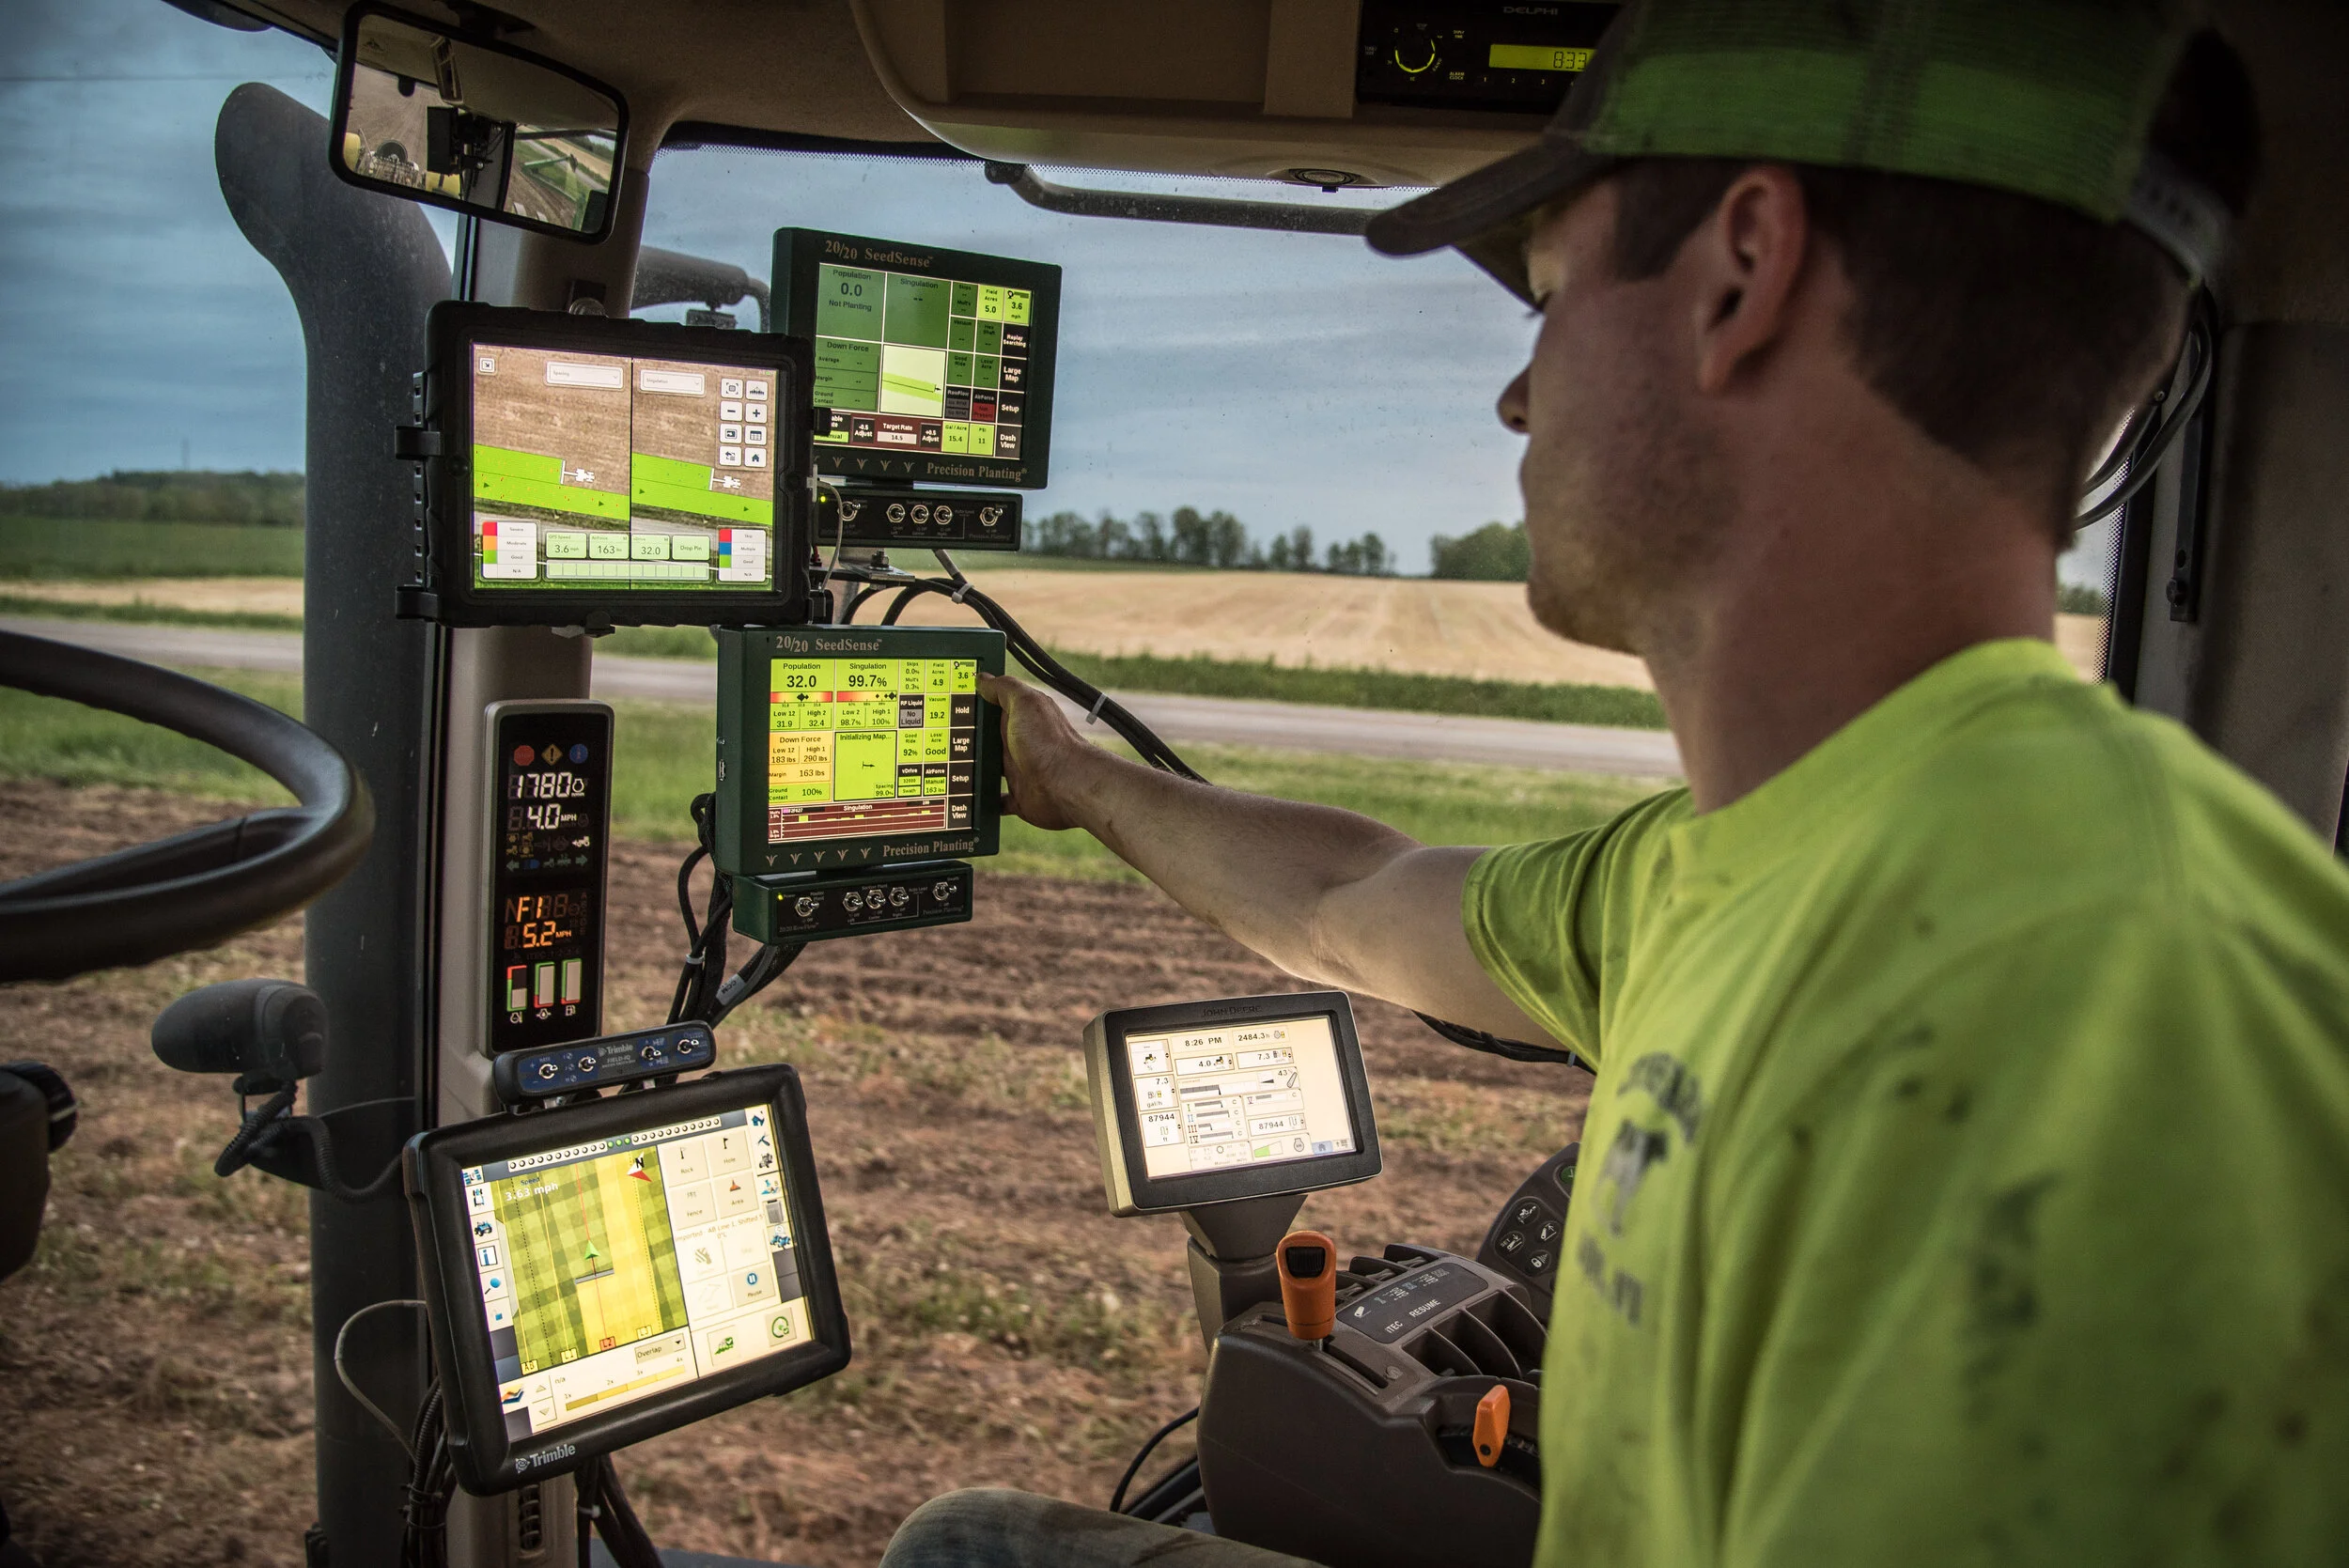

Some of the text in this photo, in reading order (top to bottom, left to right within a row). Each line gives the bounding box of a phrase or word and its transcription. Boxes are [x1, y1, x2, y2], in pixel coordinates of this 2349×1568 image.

[1502, 6, 1559, 16] DELPHI
[825, 241, 858, 260] 20/20
[833, 270, 871, 280] Population
[900, 278, 939, 288] Singulation
[841, 283, 863, 297] 0.0
[843, 301, 872, 312] Planting
[1011, 302, 1022, 310] 3.6
[827, 342, 869, 352] Down Force
[1003, 365, 1021, 376] Large
[1005, 374, 1019, 382] Map
[1001, 404, 1019, 413] Setup
[1000, 433, 1016, 442] Dash
[926, 462, 974, 477] Precision
[554, 544, 569, 553] 3.6
[598, 545, 615, 554] 163
[641, 547, 661, 555] 32.0
[776, 635, 808, 653] 20/20
[786, 675, 817, 688] 32.0
[848, 675, 887, 688] 99.7%
[518, 772, 572, 799] 1780
[527, 803, 561, 830] 4.0
[882, 843, 929, 858] Precision
[522, 920, 572, 949] 5.2 MPH
[1202, 1005, 1262, 1017] JOHN DEERE
[1185, 1036, 1222, 1047] 8:26 PM
[1237, 1032, 1266, 1042] 2484.3
[605, 1043, 634, 1055] Trimble
[1156, 1077, 1169, 1085] 7.3
[1247, 1096, 1254, 1105] V
[1148, 1113, 1175, 1123] 87944
[1188, 1114, 1194, 1123] II
[1188, 1125, 1198, 1134] III
[1258, 1121, 1284, 1130] 87944
[1190, 1135, 1199, 1144] IV
[635, 1157, 645, 1170] N
[520, 1176, 540, 1187] Speed
[505, 1183, 559, 1203] 3.63 mph
[731, 1198, 744, 1206] Area
[1500, 1238, 1511, 1248] SET
[1408, 1298, 1441, 1319] RESUME
[603, 1339, 613, 1348] L2
[637, 1345, 662, 1359] Overlap
[524, 1362, 536, 1372] AB
[554, 1375, 567, 1384] n/a
[530, 1443, 576, 1468] Trimble
